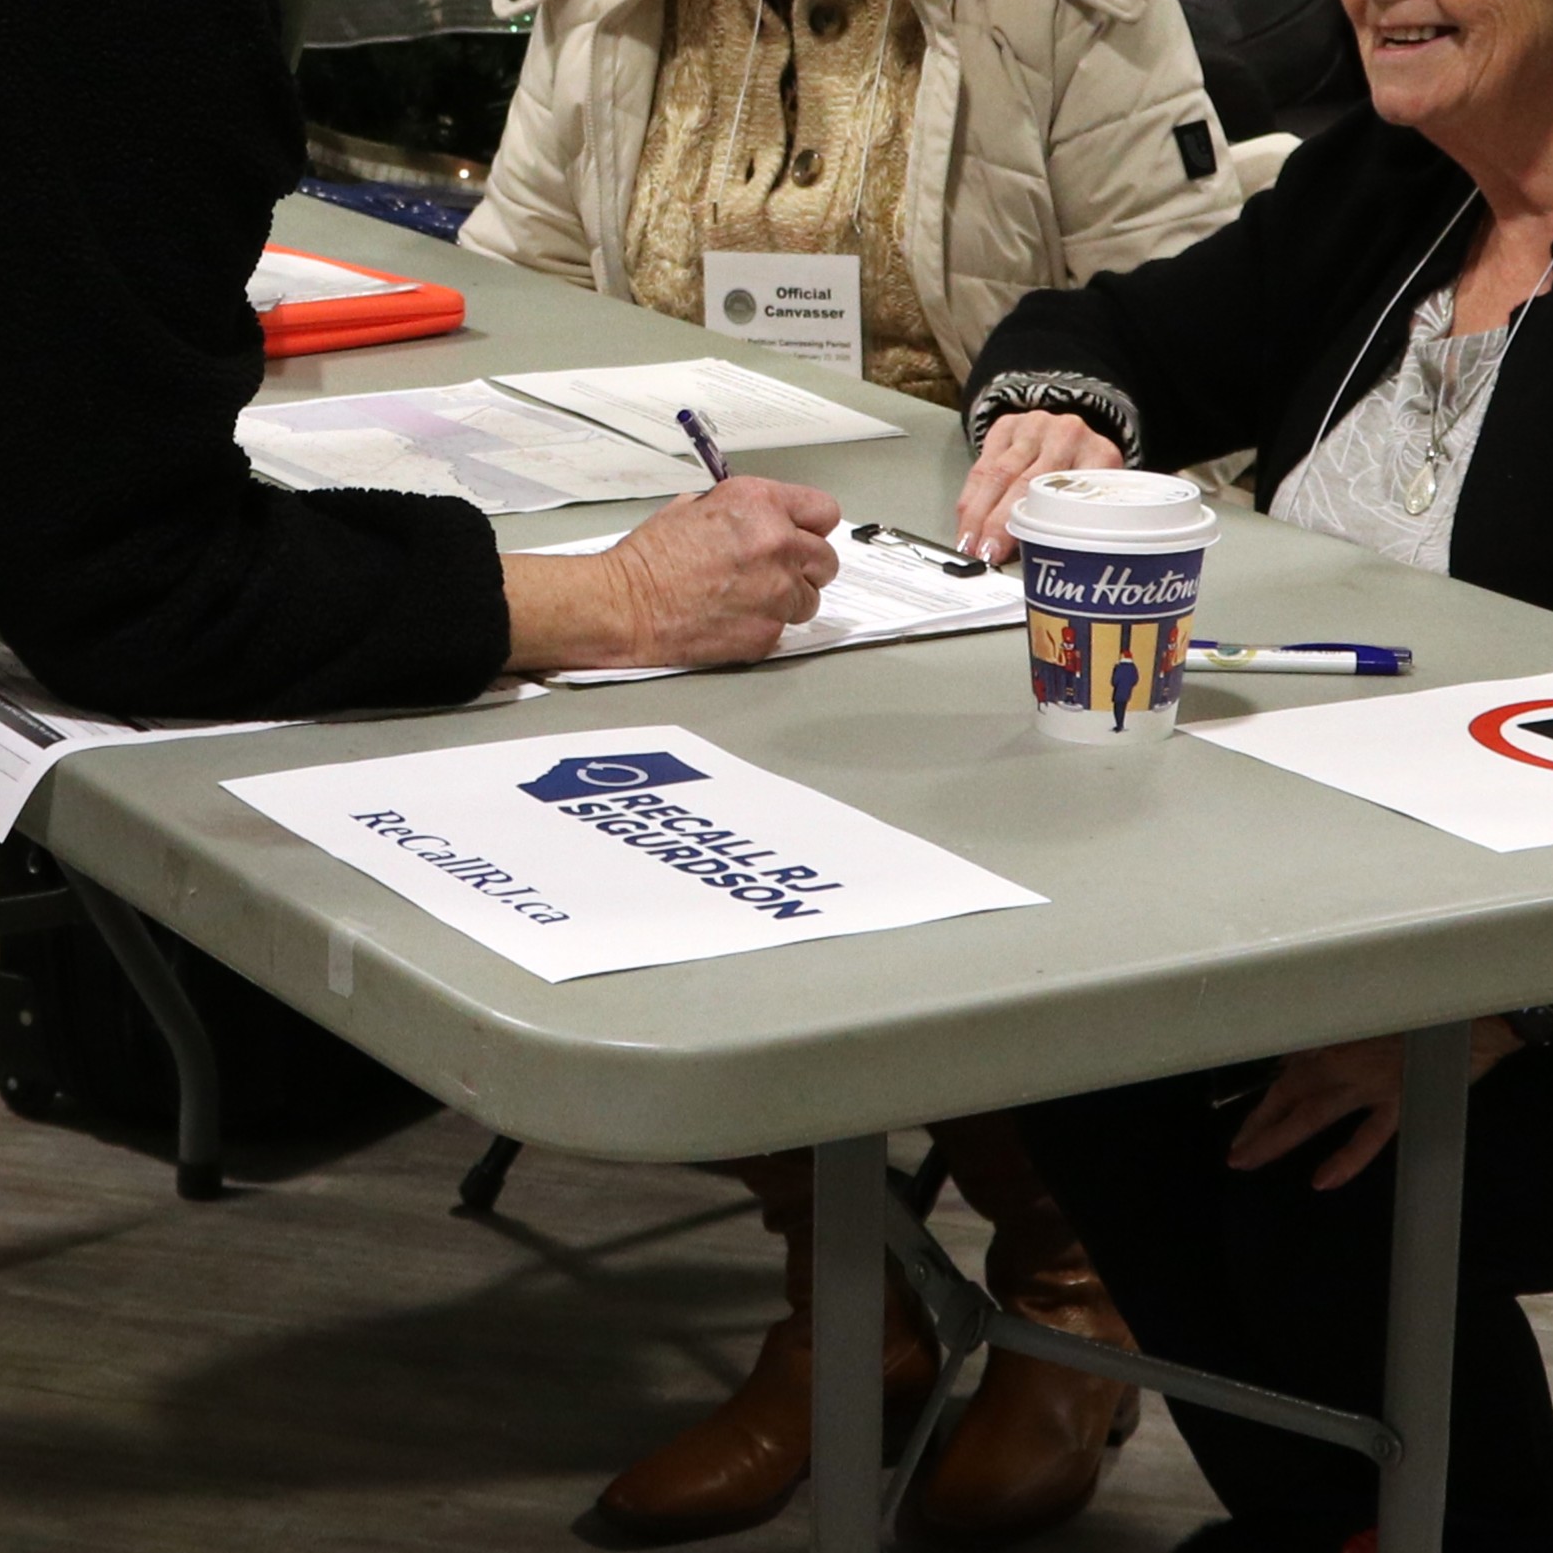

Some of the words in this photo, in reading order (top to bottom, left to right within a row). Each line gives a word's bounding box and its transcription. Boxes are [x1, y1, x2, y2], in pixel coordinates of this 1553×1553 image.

[764, 305, 845, 319] Canvasser
[775, 286, 832, 300] Official
[1032, 557, 1085, 603] Tim
[349, 809, 570, 925] ReCallRJ.ca
[558, 802, 823, 920] SIGURDSON
[607, 793, 777, 866] RECALL
[761, 865, 845, 892] RJ
